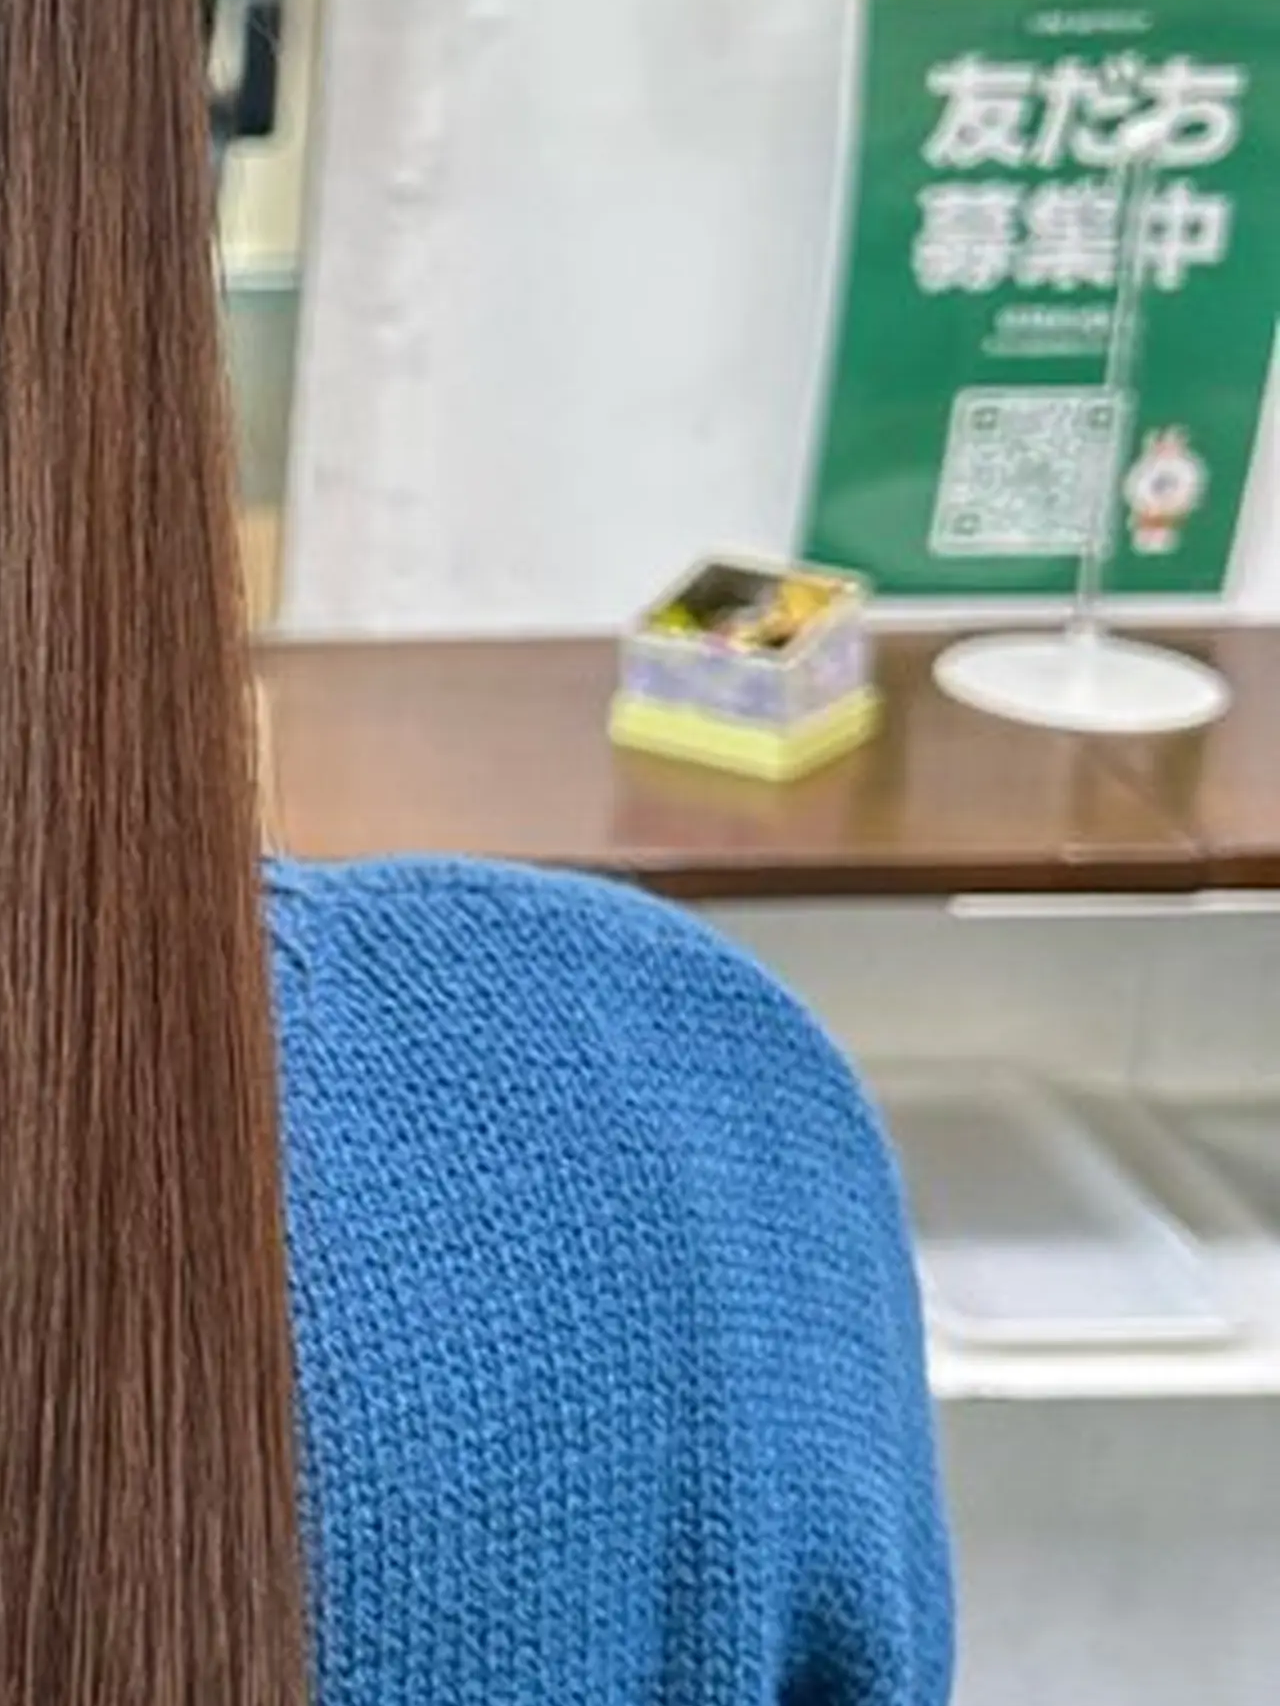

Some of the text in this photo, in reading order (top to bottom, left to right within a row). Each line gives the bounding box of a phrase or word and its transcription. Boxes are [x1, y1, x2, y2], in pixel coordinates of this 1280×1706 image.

[922, 51, 1248, 169] 友だち
[912, 179, 1232, 292] 募集中
